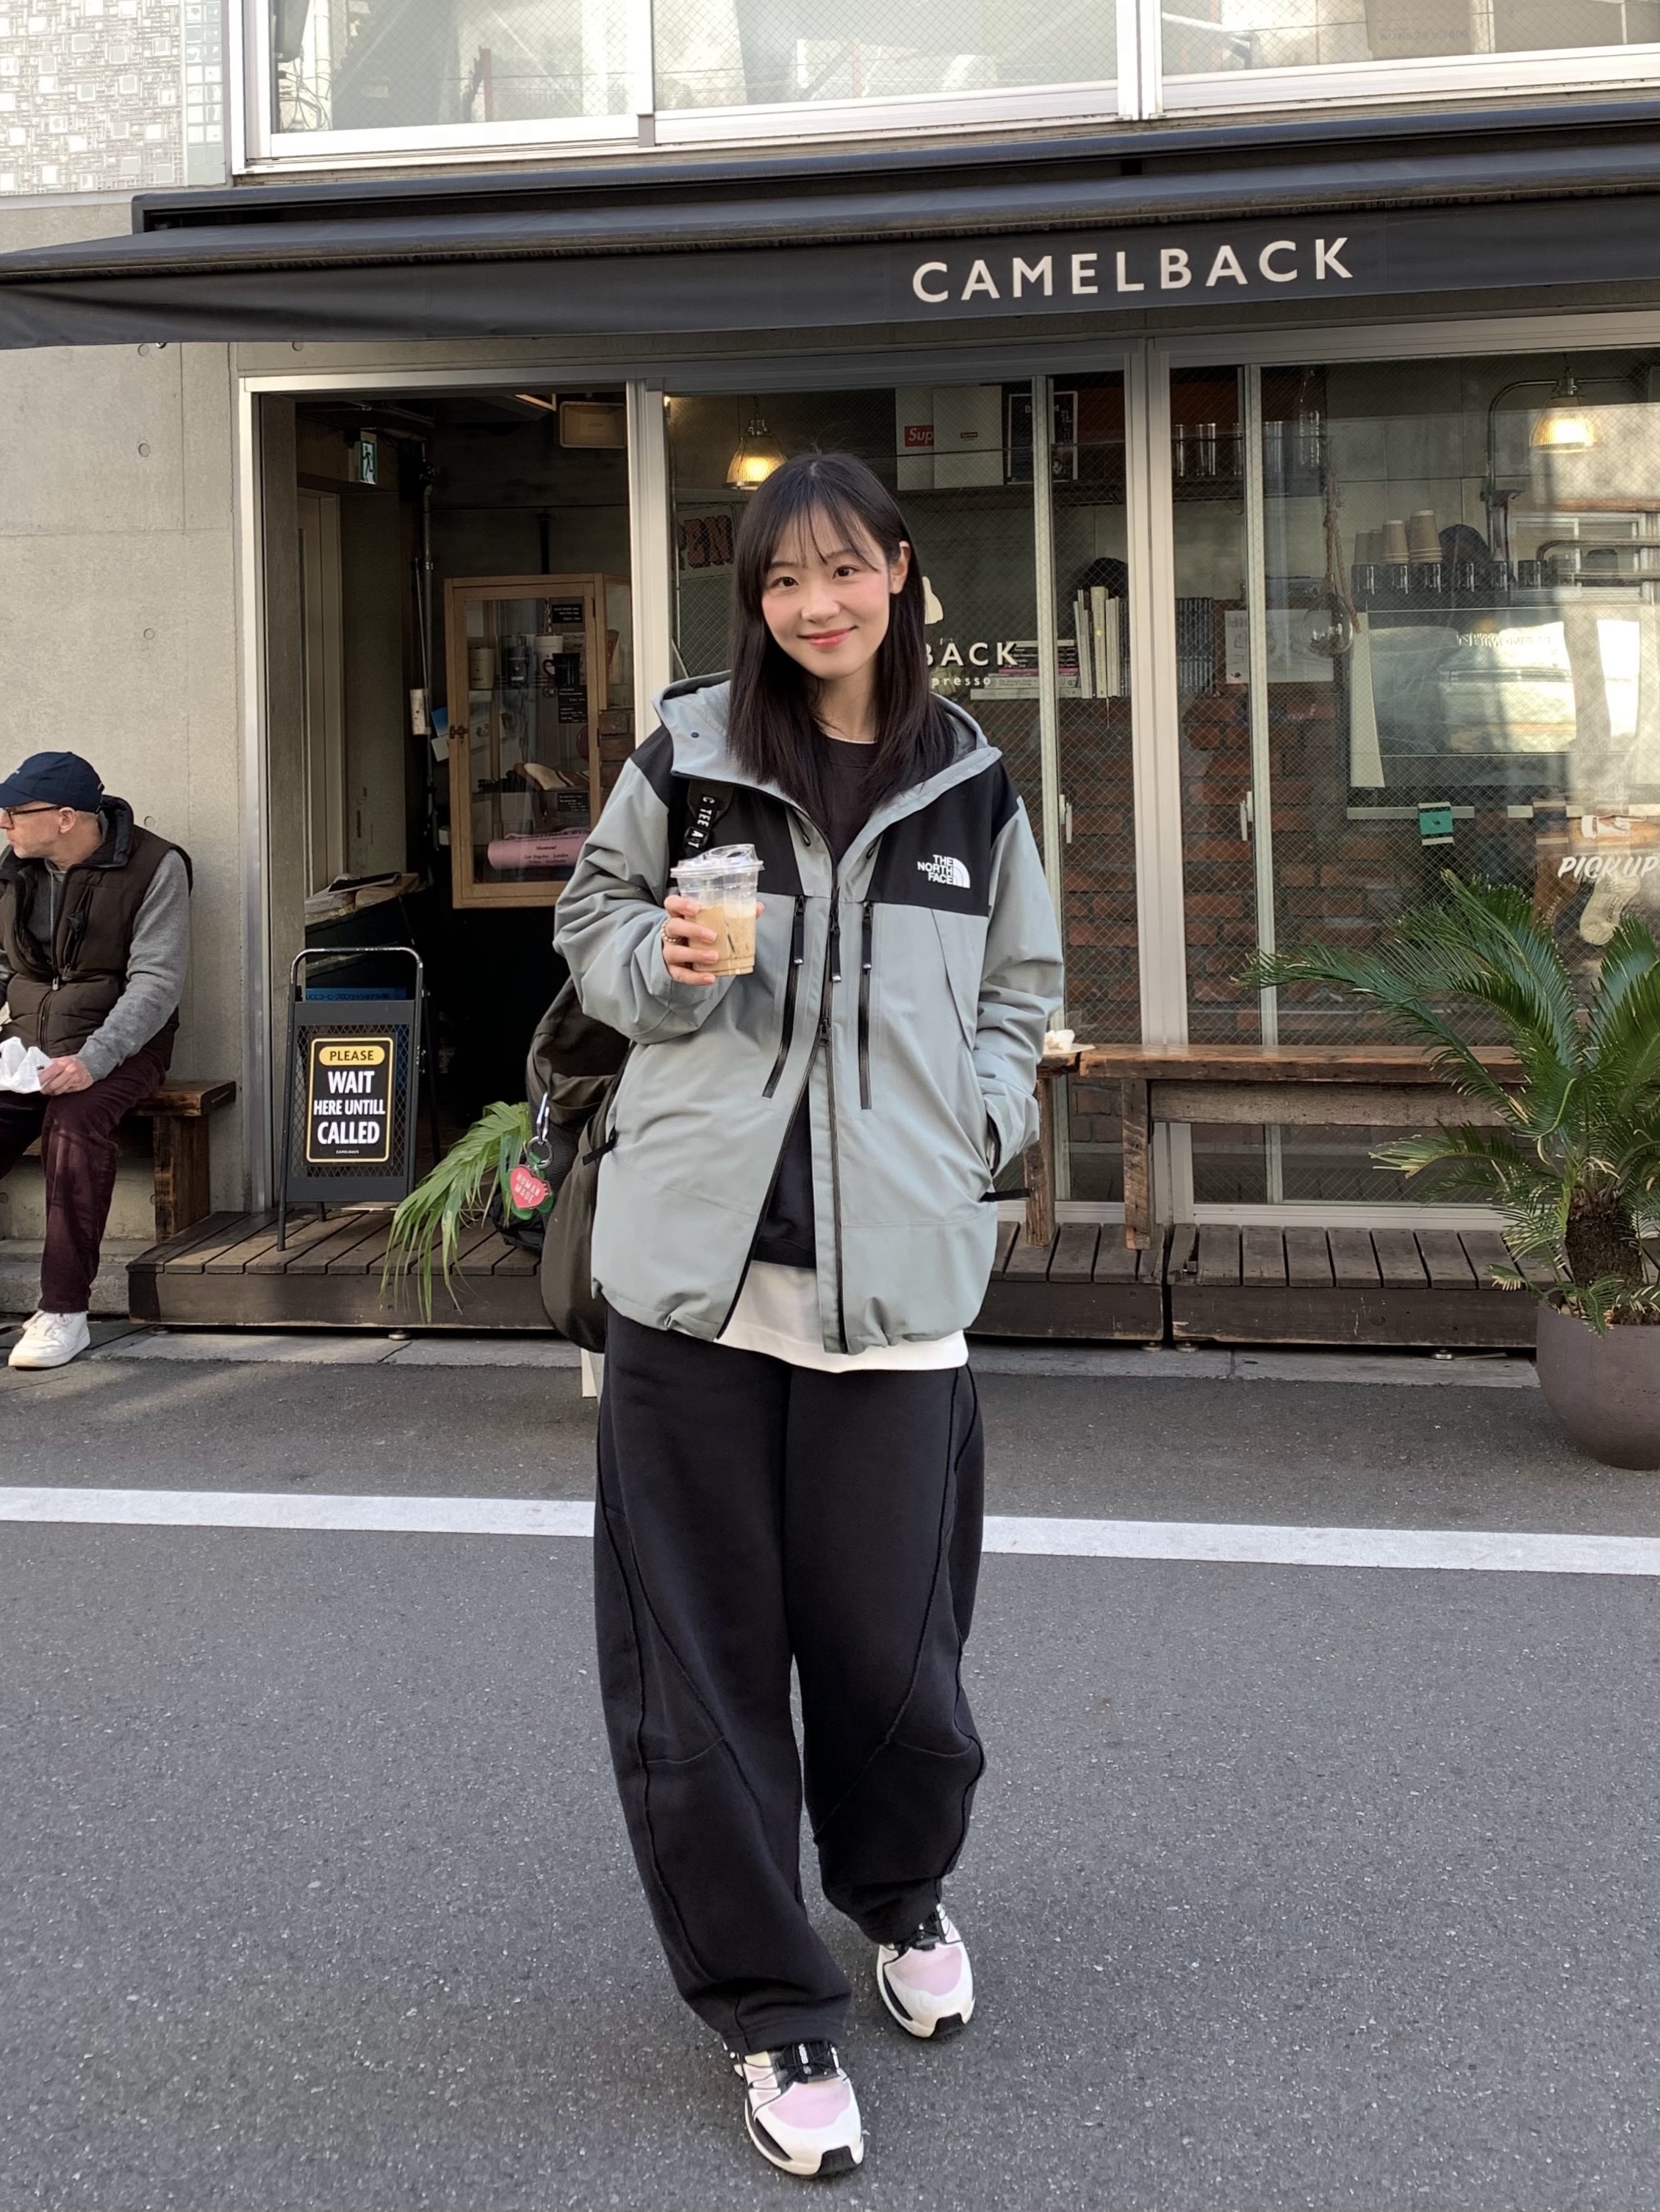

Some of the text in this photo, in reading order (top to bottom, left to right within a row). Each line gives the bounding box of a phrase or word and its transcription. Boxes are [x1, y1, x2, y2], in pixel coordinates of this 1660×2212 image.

[912, 237, 1353, 304] CAMELBACK
[908, 427, 933, 445] Sup
[931, 676, 991, 689] presso
[917, 861, 953, 875] NORTH
[933, 854, 954, 866] THE
[1557, 855, 1659, 879] PICK UP
[928, 872, 953, 885] FACE
[330, 1050, 374, 1061] PLEASE
[328, 1070, 375, 1094] WAIT
[314, 1099, 386, 1116] HERE UNTILL
[317, 1121, 380, 1144] CALLED
[514, 1183, 535, 1204] MADE
[517, 1172, 541, 1197] HUMAN
